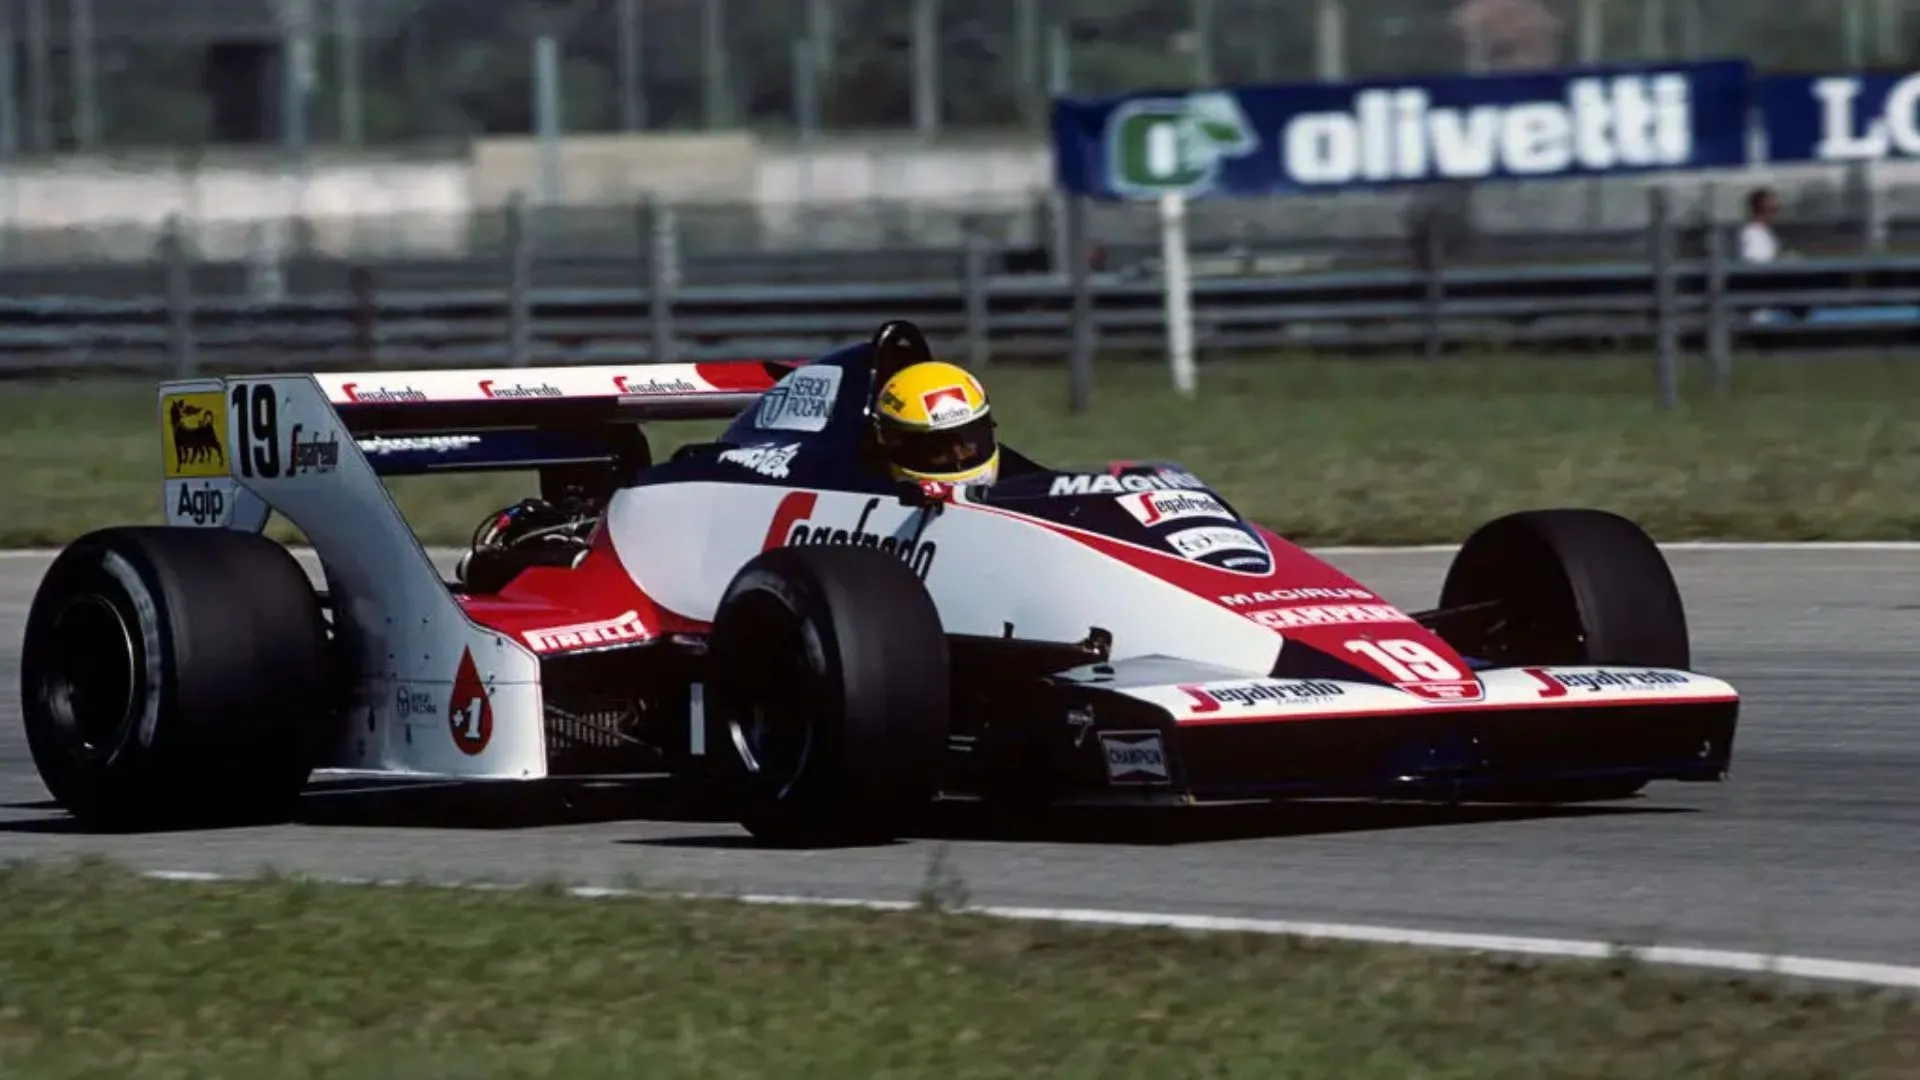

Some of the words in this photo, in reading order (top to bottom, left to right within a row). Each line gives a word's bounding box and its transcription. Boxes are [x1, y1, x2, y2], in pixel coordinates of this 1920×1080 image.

[1285, 73, 1690, 183] olivetti
[231, 383, 280, 479] 19
[177, 483, 224, 525] Agip
[1220, 587, 1374, 607] MAGIRUS
[522, 610, 650, 651] PIRELLI
[1344, 639, 1461, 681] 19
[1177, 681, 1344, 713] Segafredo
[1523, 668, 1690, 698] Segafredo
